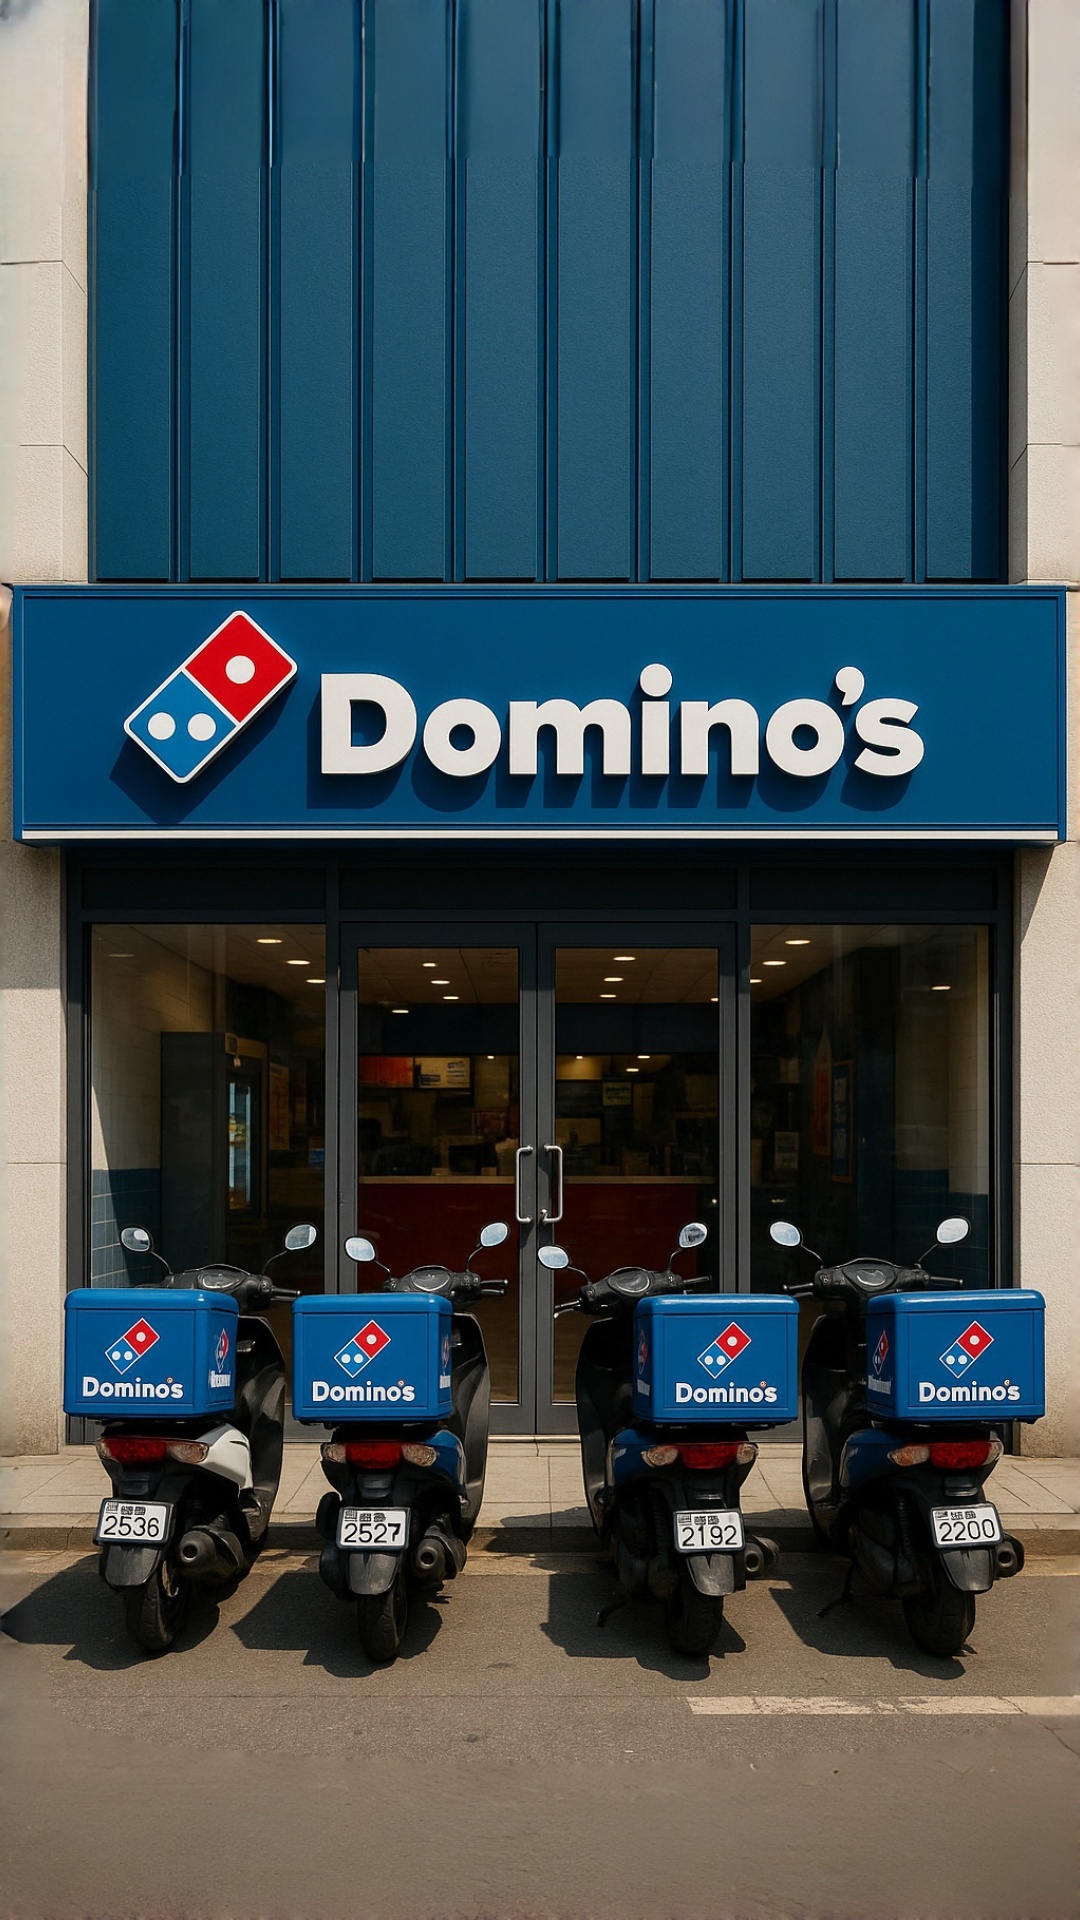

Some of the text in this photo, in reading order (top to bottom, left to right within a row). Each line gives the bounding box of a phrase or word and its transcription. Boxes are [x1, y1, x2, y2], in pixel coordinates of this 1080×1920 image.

[321, 663, 925, 777] Domino's
[103, 1515, 160, 1537] 2536
[343, 1522, 401, 1543] 2527
[682, 1524, 738, 1547] 2192
[939, 1518, 996, 1542] 2200
